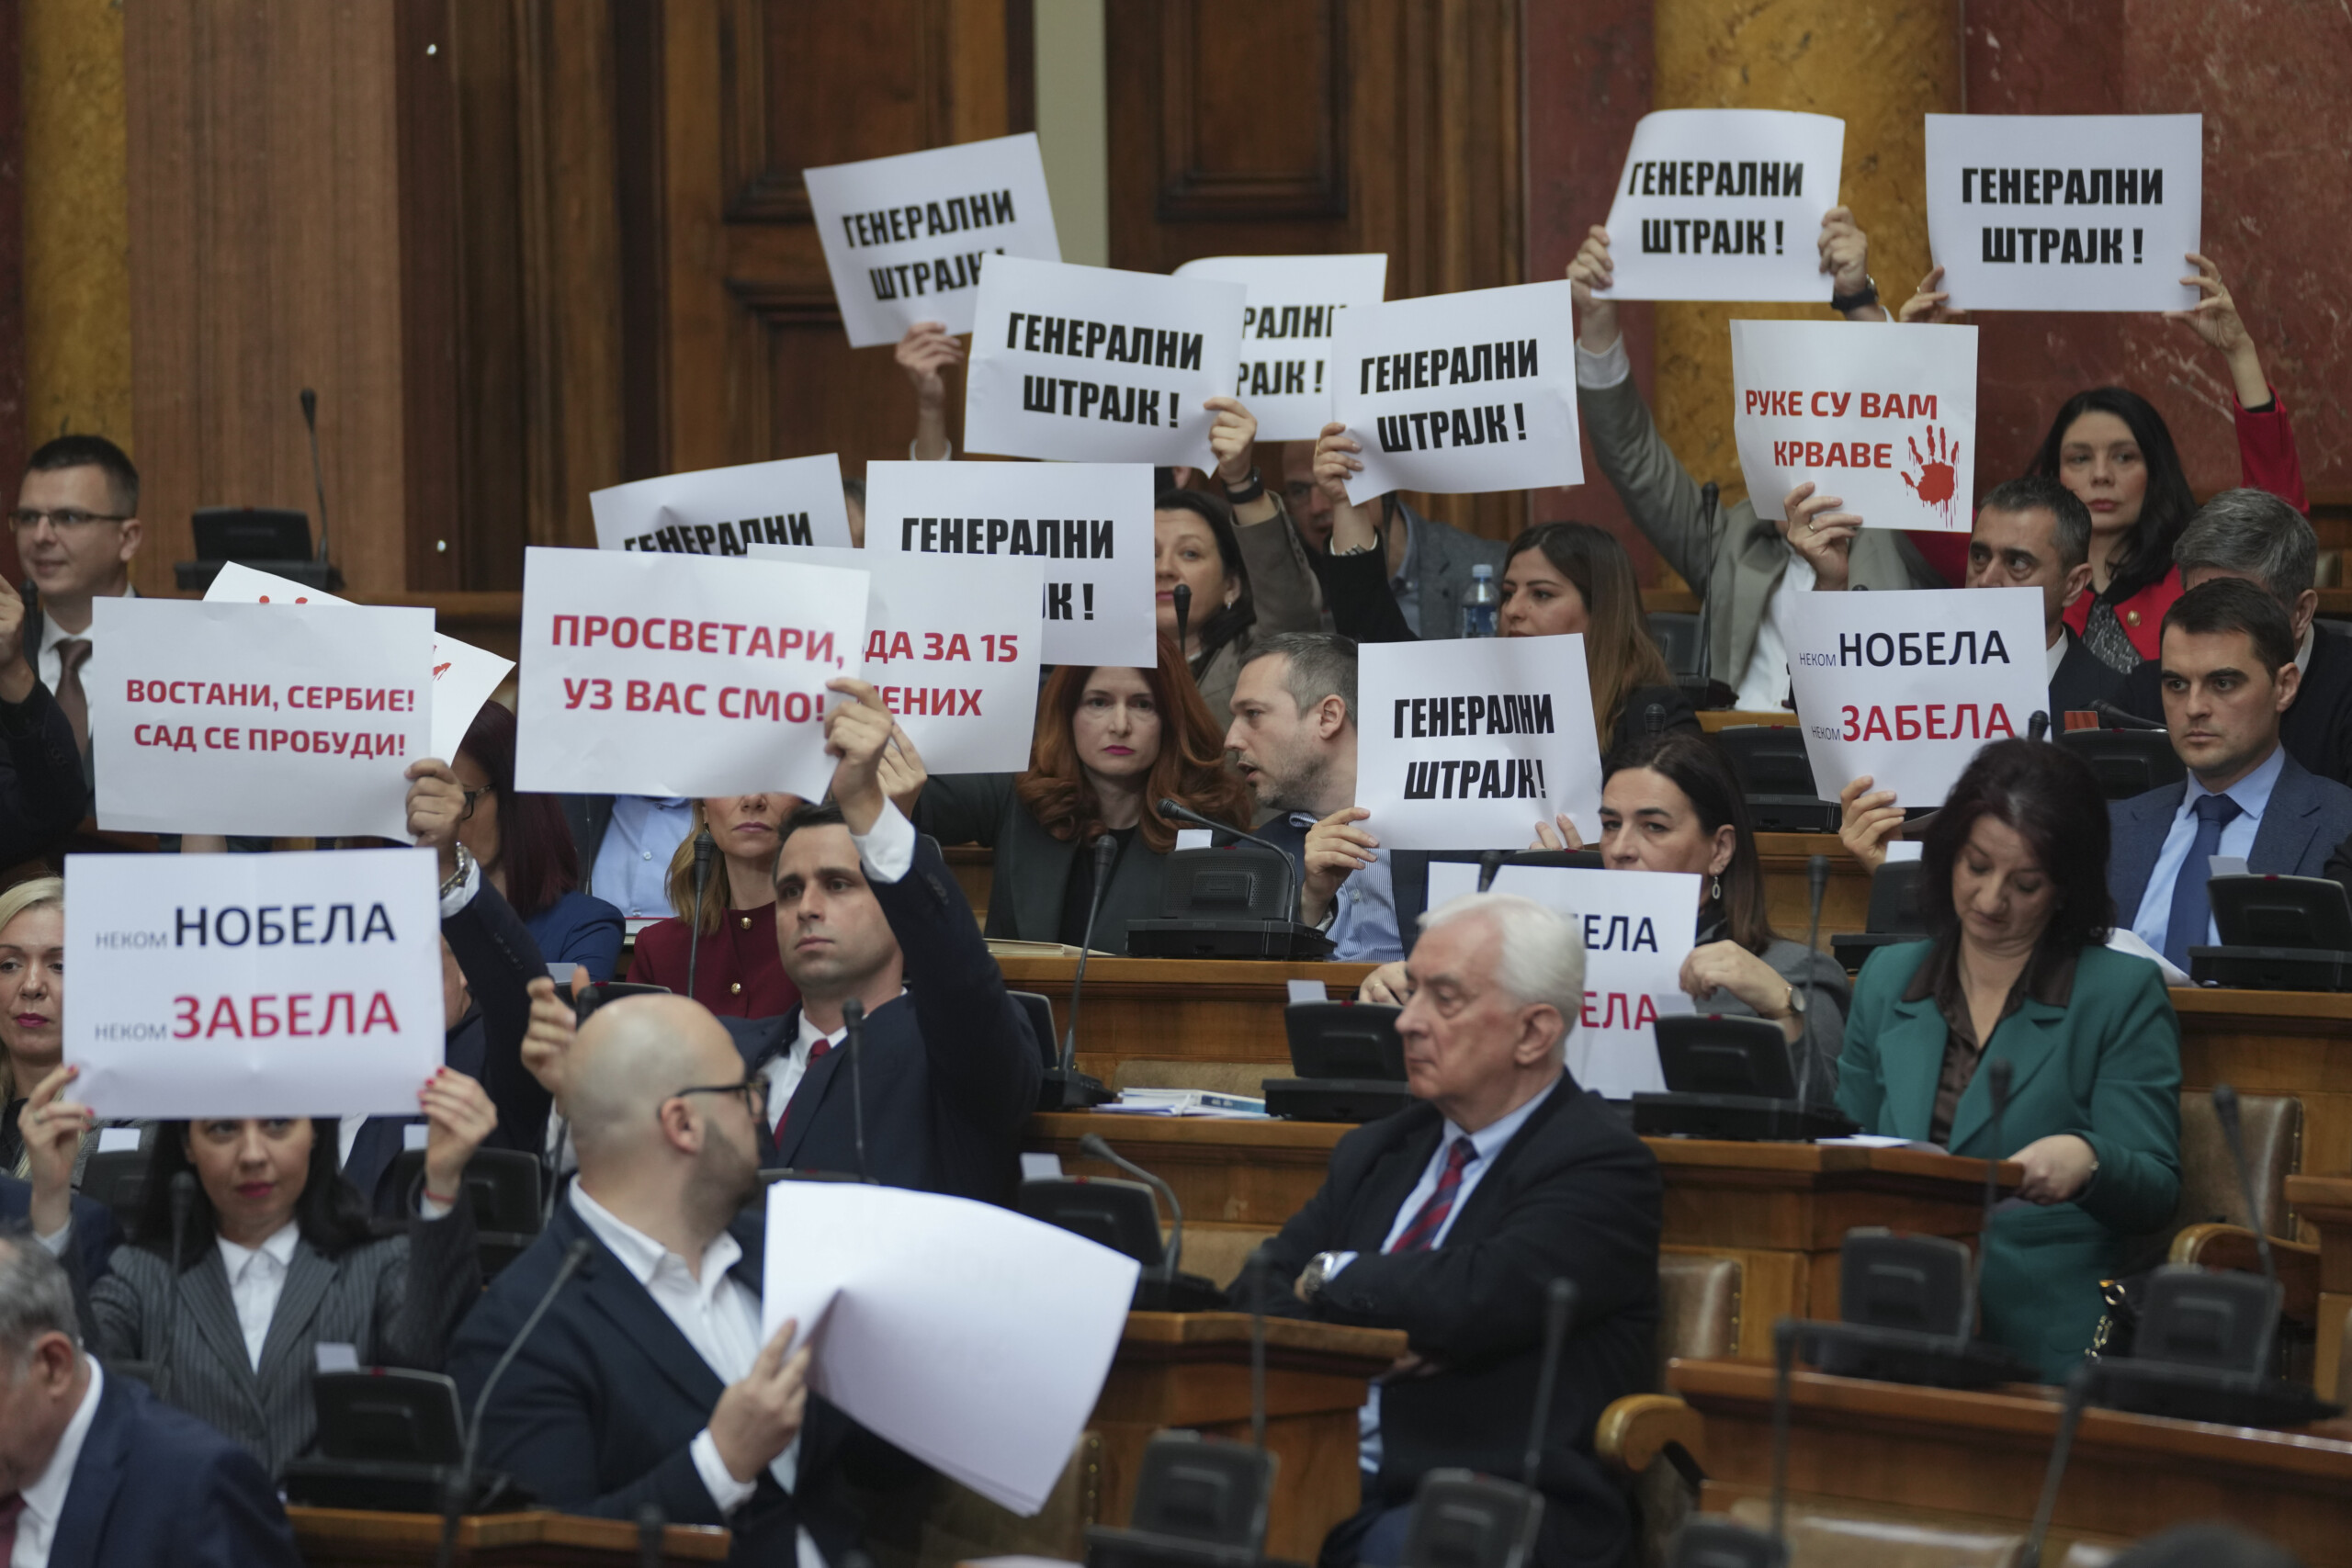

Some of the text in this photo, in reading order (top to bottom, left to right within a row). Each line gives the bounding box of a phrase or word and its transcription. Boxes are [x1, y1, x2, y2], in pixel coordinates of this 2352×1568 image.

[1628, 161, 1804, 197] ГЕНЕРАЛНИ
[1962, 167, 2164, 205] ГЕНЕРАЛНИ
[842, 189, 1016, 249] ГЕНЕРАЛНИ
[1006, 311, 1204, 371] ГЕНЕРАЛНИ
[1360, 338, 1539, 395] ГЕНЕРАЛНИ
[1745, 389, 1938, 421] РУКЕ СУ ВАМ
[1773, 440, 1893, 468] КРВАВЕ
[901, 517, 1114, 559] ГЕНЕРАЛНИ
[551, 614, 843, 669] ПРОСВЕТАРИ,
[865, 629, 1018, 665] ДА ЗА 15
[1798, 629, 2010, 668] НЕКОМ НОБЕЛА
[126, 679, 414, 712] ВОСТАНИ, СЕРБИЕ!
[563, 677, 825, 723] УЗ ВАС СМО!
[1394, 694, 1555, 739] ГЕНЕРАЛНИ
[1810, 703, 2016, 742] НЕКОМ ЗАБЕЛА
[134, 724, 405, 761] САД СЕ ПРОБУДИ!
[95, 902, 396, 950] НЕКОМ НОБЕЛА
[94, 991, 400, 1041] НЕКОМ ЗАБЕЛА
